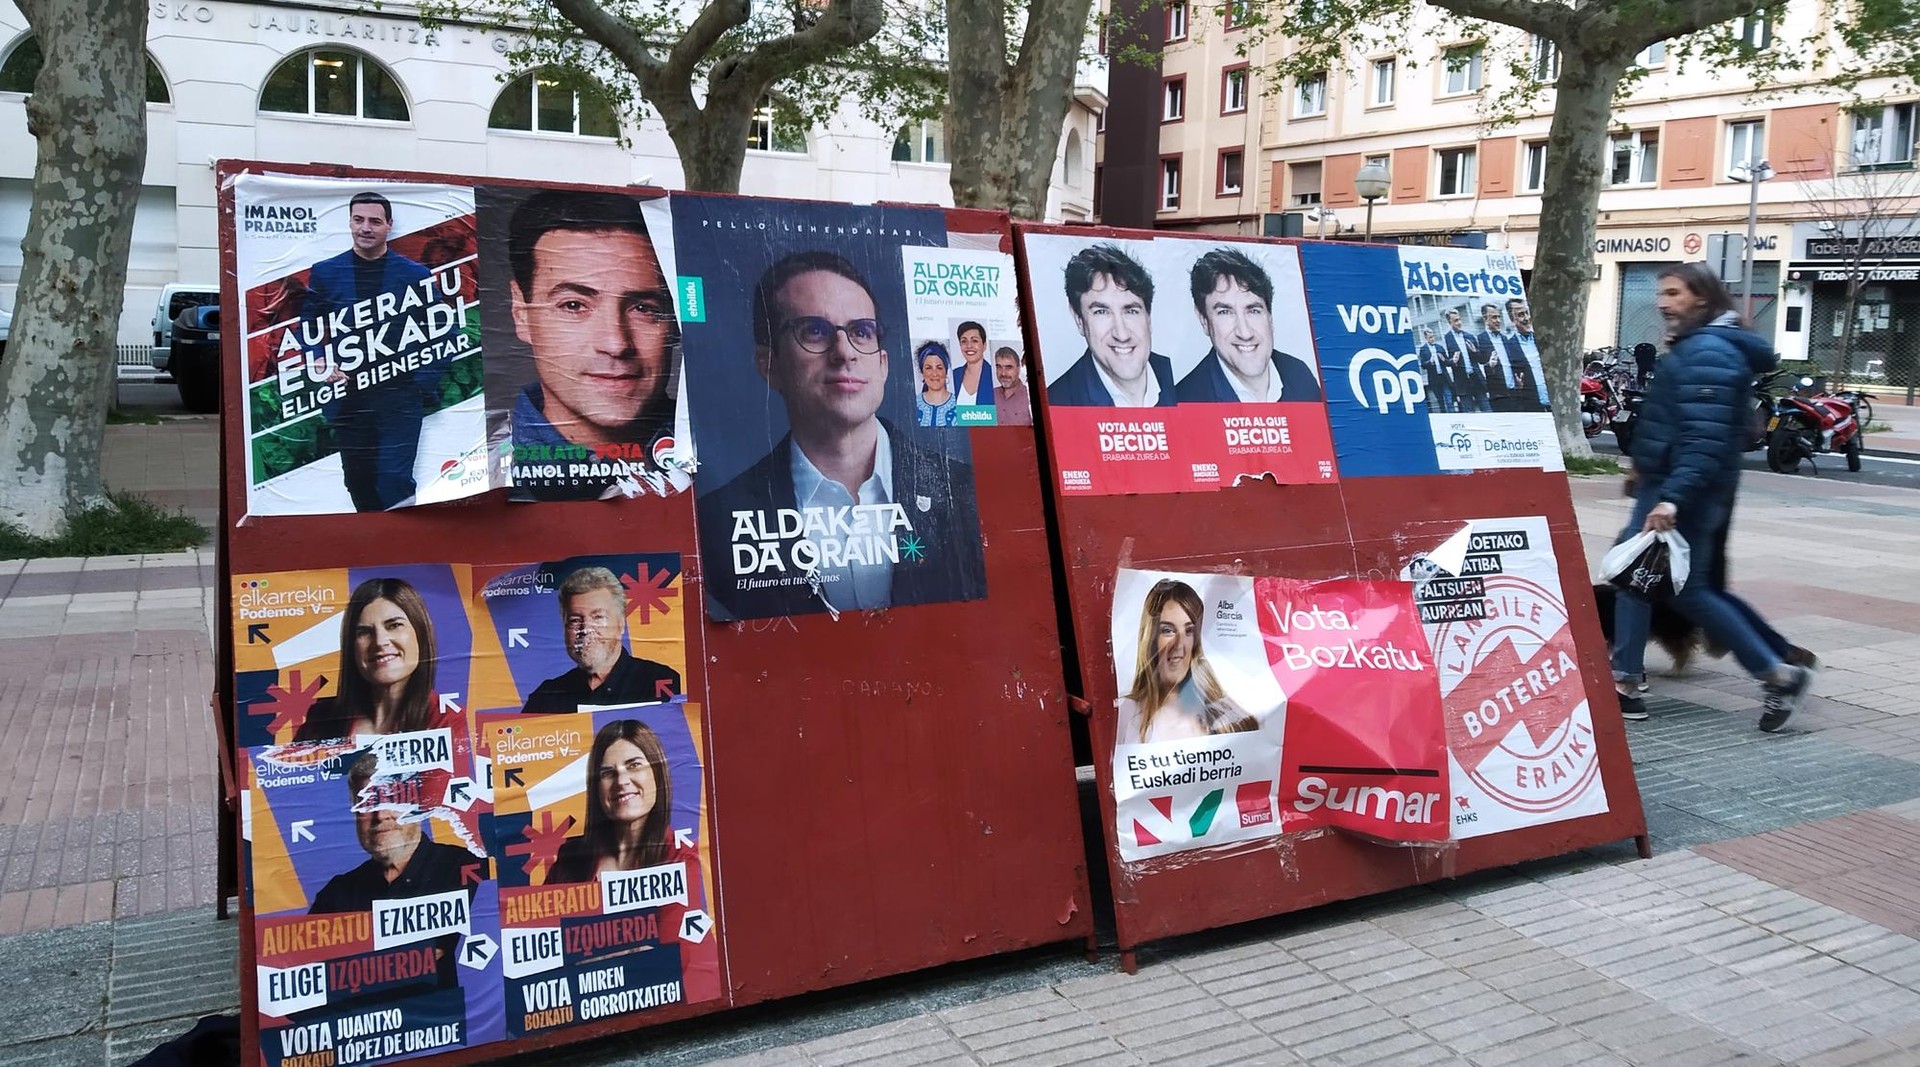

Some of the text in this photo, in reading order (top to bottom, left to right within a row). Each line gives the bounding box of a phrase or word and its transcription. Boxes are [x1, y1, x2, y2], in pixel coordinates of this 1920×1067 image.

[155, 4, 214, 23] SKO
[249, 13, 440, 47] JAURLARITZA
[245, 205, 317, 220] IMANOL
[245, 220, 317, 233] PRADALES
[702, 219, 923, 237] PELLO LEHENDAKARI
[1595, 237, 1671, 253] GIMNASIO
[1810, 240, 1920, 255] Tabena ATXARR
[1486, 254, 1517, 271] Ireki
[914, 280, 999, 298] DA ORAIN
[1403, 260, 1523, 296] Abiertos
[685, 281, 698, 318] ehbildu
[277, 267, 461, 358] AUKERATU
[1337, 304, 1412, 335] VOTA
[278, 296, 467, 396] EUSKADI
[282, 334, 470, 419] ELIGE BIENESTAR
[961, 410, 993, 421] ehbildu
[1097, 421, 1165, 433] VOTA AL QUE
[1223, 416, 1288, 428] VOTA AL QUE
[1099, 433, 1168, 452] DECIDE
[1225, 428, 1291, 446] DECIDE
[502, 442, 587, 461] OZKATU
[594, 443, 643, 460] VOTA
[1102, 453, 1136, 461] ERABAKIA
[1136, 453, 1160, 461] ZUREA
[1228, 447, 1261, 455] ERABAKIA
[1261, 446, 1282, 454] ZUREA
[569, 461, 646, 477] PRADALES
[1062, 470, 1090, 479] ENEKO
[1191, 463, 1218, 472] ENEKO
[731, 503, 913, 542] ALDAKETA
[1466, 534, 1524, 551] IOETAKO
[732, 535, 900, 575] DA ORAIN
[736, 574, 840, 591] El futuro en tus anos
[1420, 580, 1482, 598] FALTSUEN
[240, 585, 335, 607] elkarrekin
[1218, 600, 1234, 610] Alba
[240, 606, 304, 620] Podemos
[1216, 610, 1243, 620] García
[1269, 601, 1359, 634] Vota.
[1422, 602, 1483, 621] AURREAN
[1447, 595, 1543, 674] LANGILE
[1282, 638, 1424, 673] Bozkatu
[1462, 650, 1577, 739] BOTEREA
[384, 735, 449, 767] KERRA
[496, 729, 581, 753] elkarrekin
[496, 751, 554, 765] Podemos
[1127, 747, 1236, 772] Es tu tiempo.
[1516, 722, 1592, 789] ERAIKI
[256, 775, 315, 789] Podemos
[1130, 763, 1242, 790] Euskadi berria
[1294, 776, 1440, 825] Sumar
[1242, 812, 1271, 825] Sumar
[1456, 813, 1479, 824] EHKS
[505, 870, 685, 924] AUKERATU EZKERRA
[262, 898, 466, 957] AUKERATU EZKERRA
[511, 914, 660, 965] ELIGE IZQUIERDA
[269, 946, 438, 1002] ELIGE IZQUIERDA
[578, 966, 625, 995] MIREN
[522, 977, 572, 1013] VOTA
[580, 980, 681, 1021] GORROTXATEGI
[336, 1008, 403, 1041] JUANTXO
[524, 1006, 574, 1031] BOZKATU
[280, 1022, 333, 1057] VOTA
[337, 1022, 460, 1065] LÓPEZ DE URALDE
